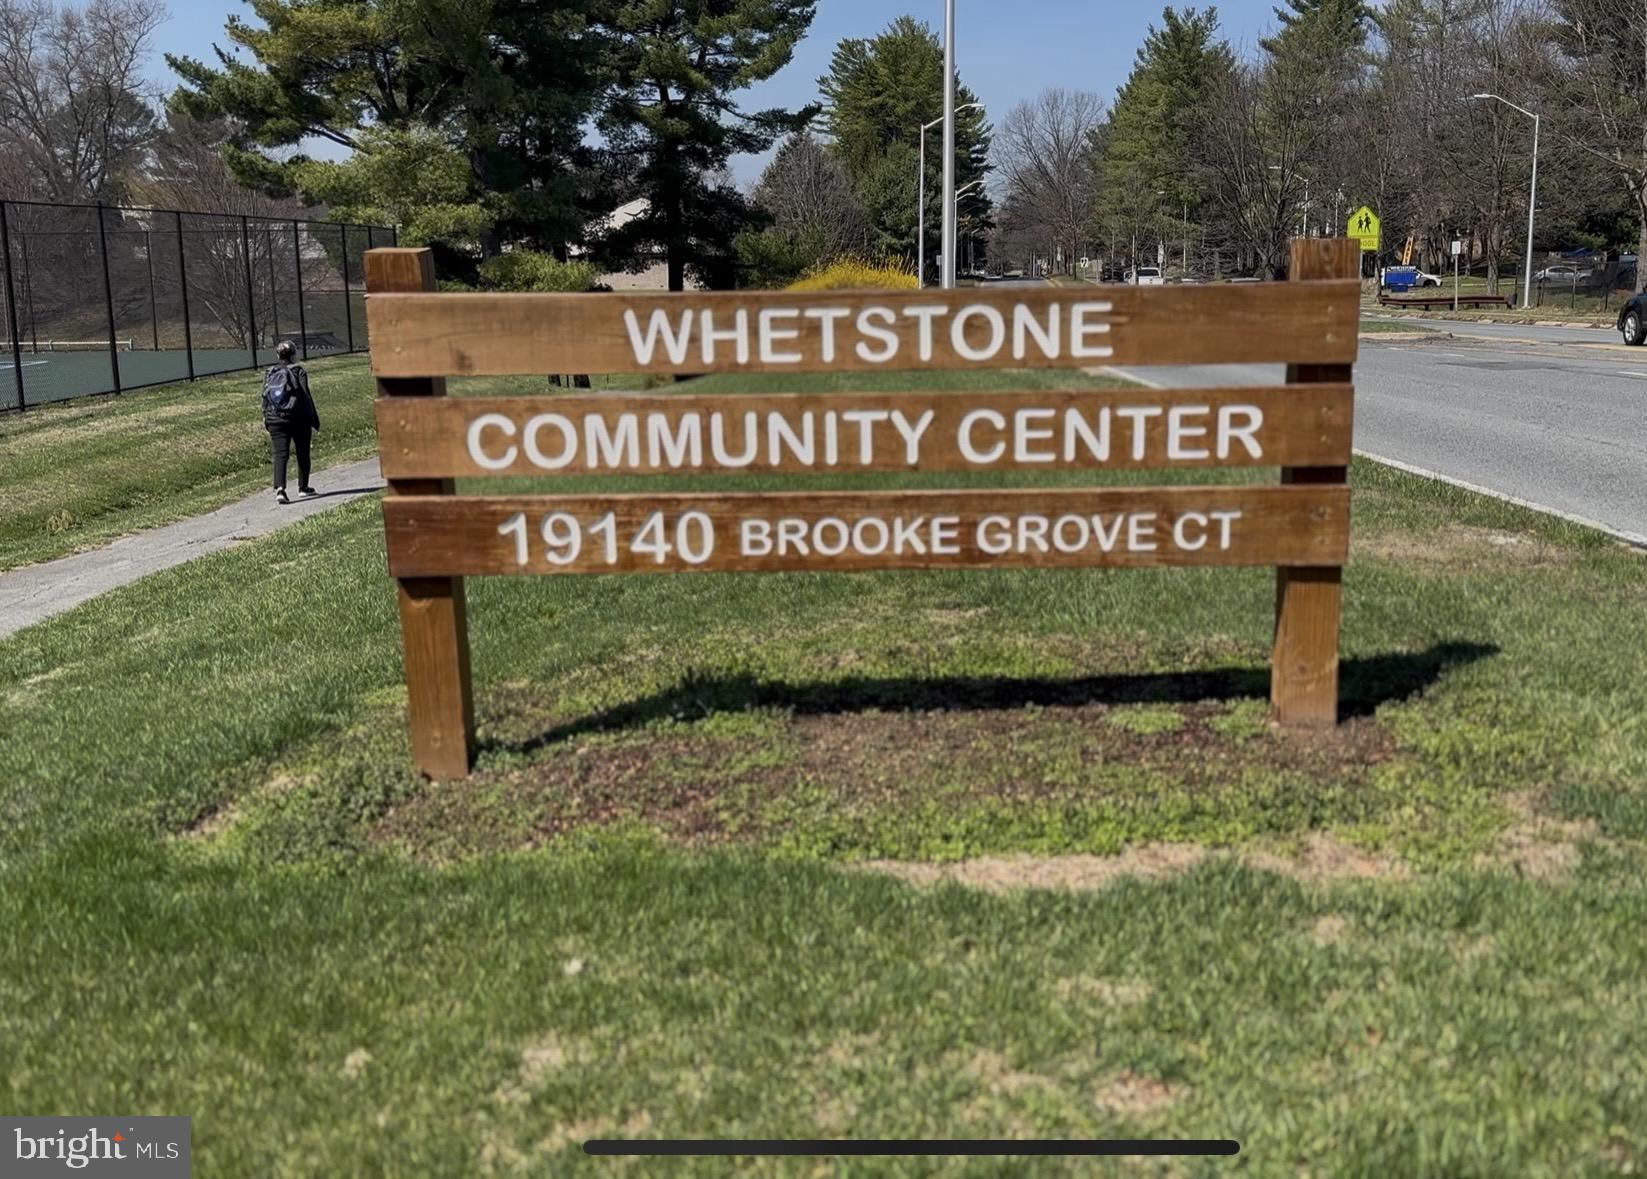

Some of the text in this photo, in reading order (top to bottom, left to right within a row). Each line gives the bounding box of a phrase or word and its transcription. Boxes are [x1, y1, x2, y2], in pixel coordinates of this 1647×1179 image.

[623, 302, 1114, 367] WHETSTONE
[466, 404, 1264, 470] COMMUNITY CENTER
[497, 510, 1243, 565] 19140 BROOKE GROVE CT
